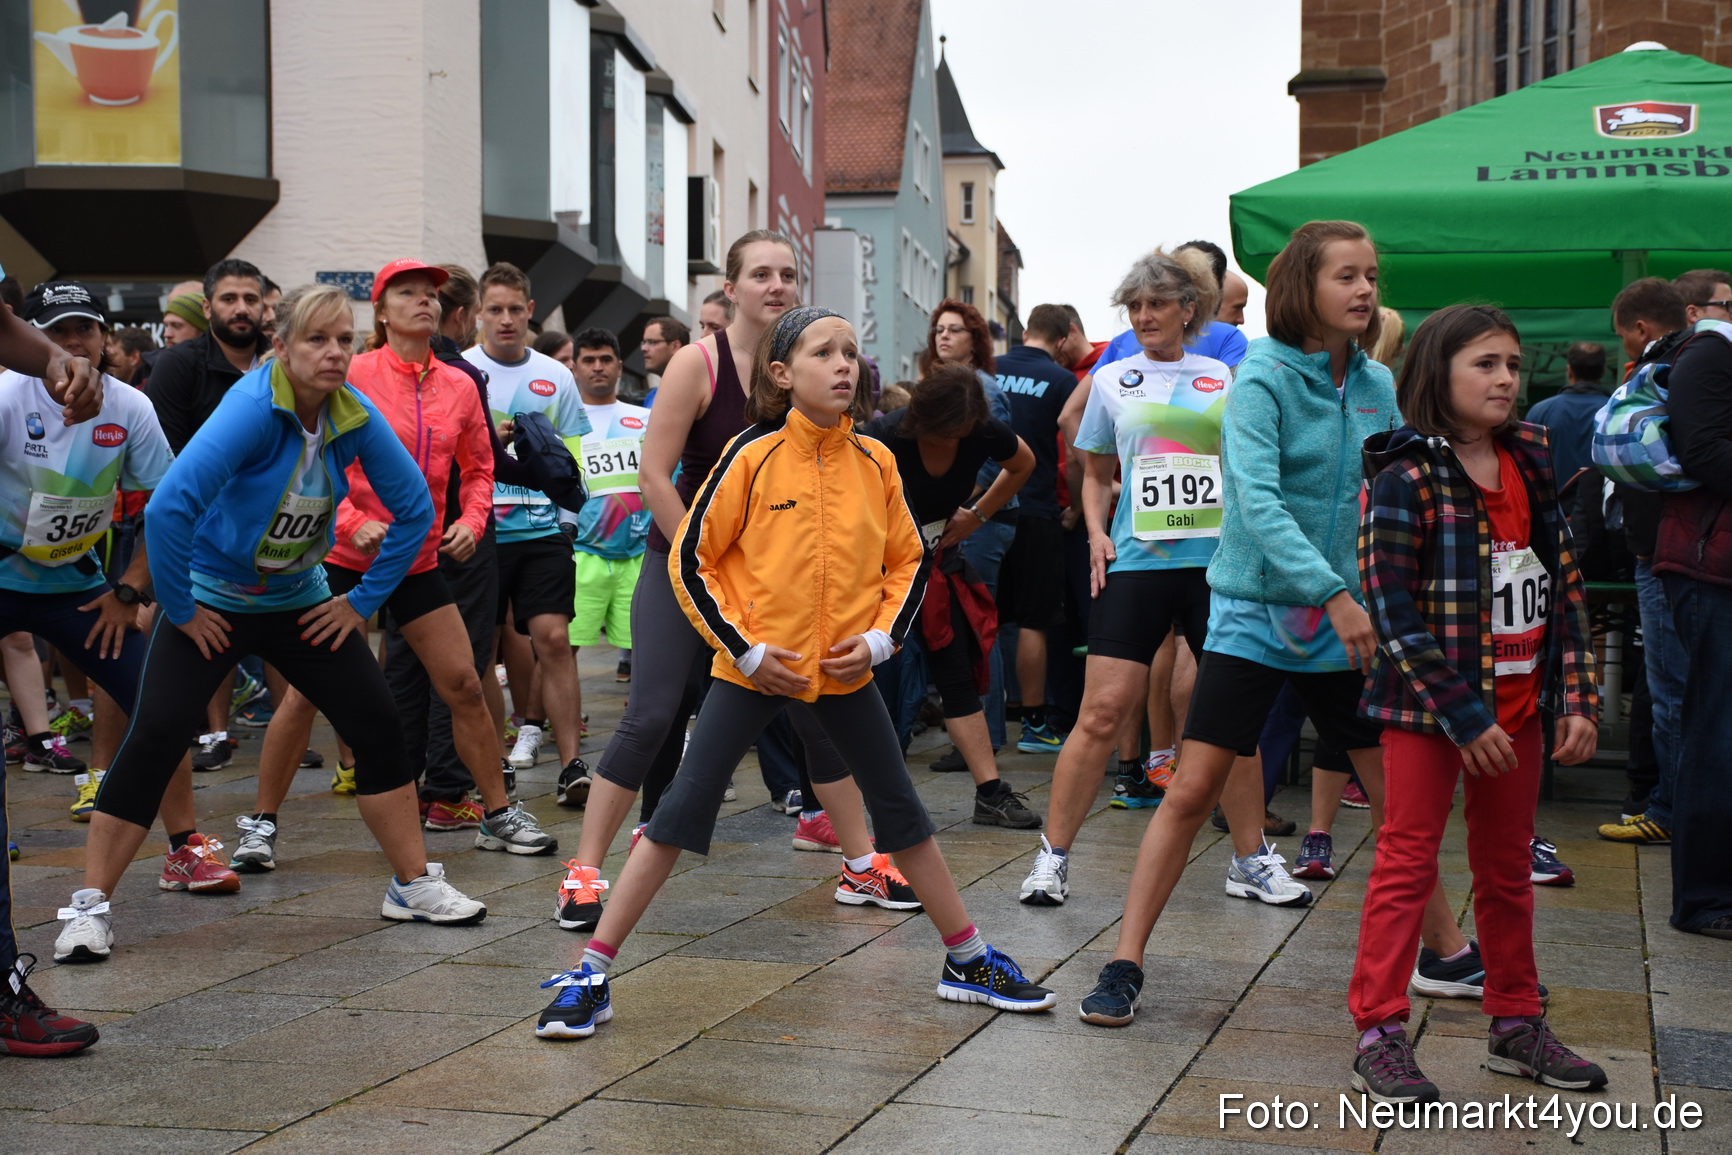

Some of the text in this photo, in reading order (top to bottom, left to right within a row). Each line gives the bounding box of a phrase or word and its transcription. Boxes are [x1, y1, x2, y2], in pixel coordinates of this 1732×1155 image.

[1476, 159, 1730, 182] Lammsb
[532, 382, 555, 393] Hervis
[95, 429, 124, 441] Hervis
[587, 451, 639, 475] 5314
[1172, 456, 1213, 469] BOCK
[1142, 474, 1217, 507] 5192
[769, 503, 792, 511] JAKO
[46, 509, 104, 543] 356
[1166, 514, 1195, 527] Gabi
[49, 542, 84, 559] Gisela
[259, 545, 291, 558] Anke
